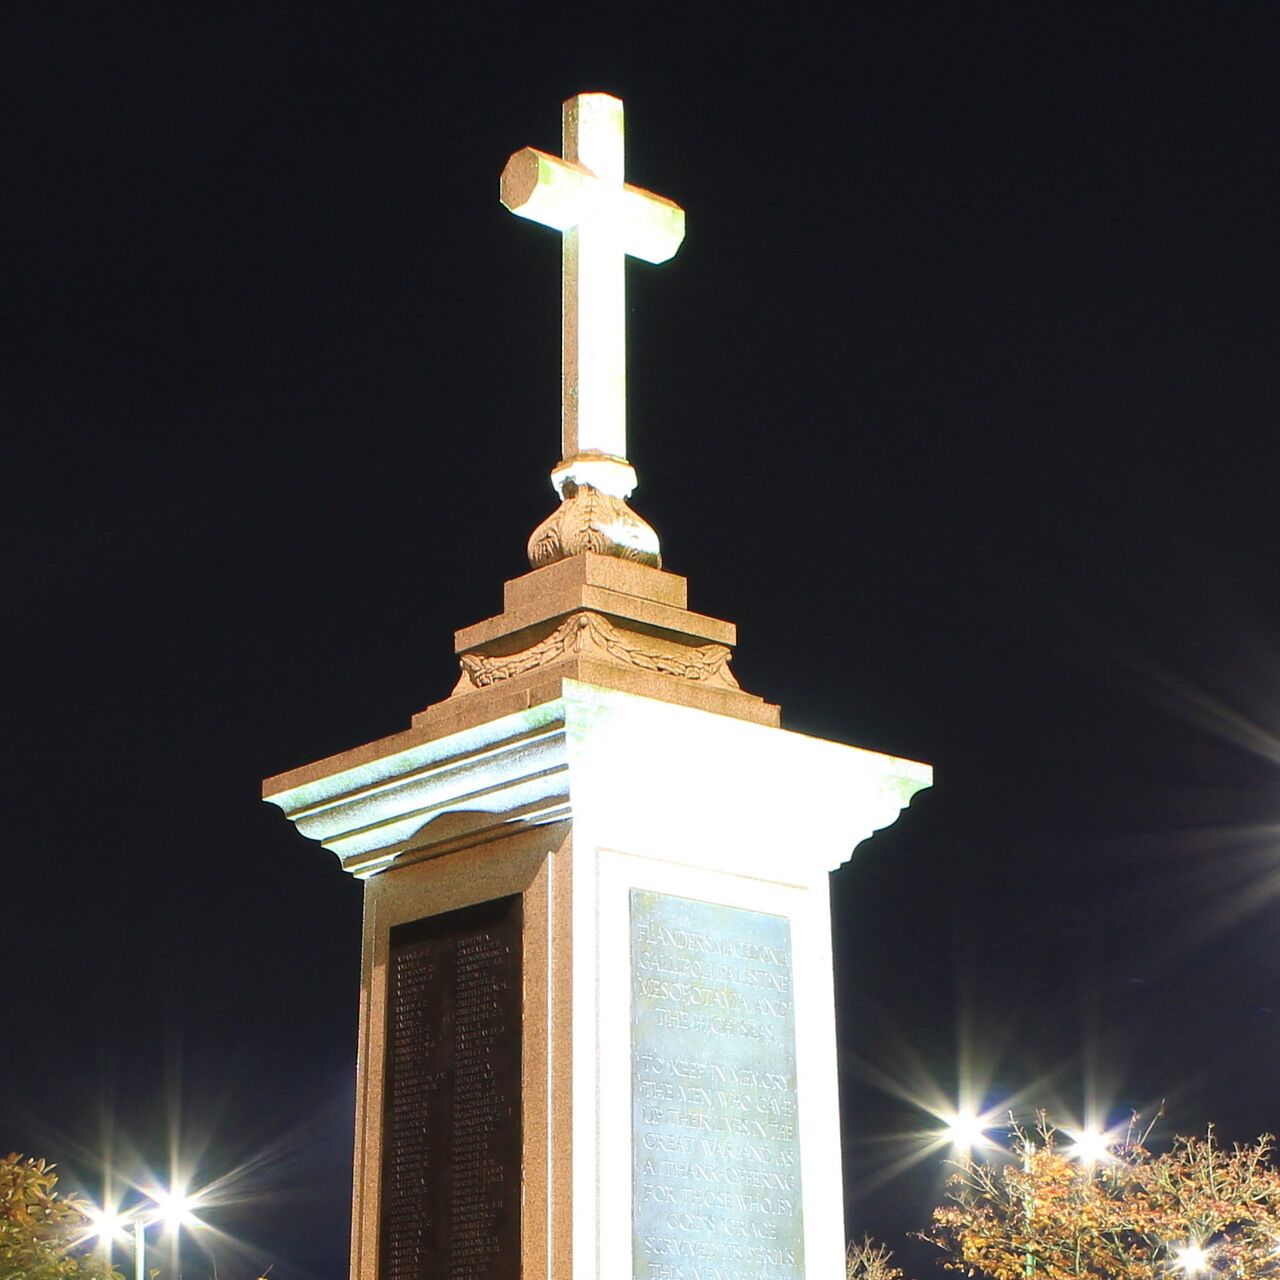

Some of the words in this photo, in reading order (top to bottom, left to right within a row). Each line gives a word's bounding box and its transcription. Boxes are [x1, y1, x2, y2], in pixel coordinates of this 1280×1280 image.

[655, 1007, 689, 1029] THE
[694, 1013, 737, 1036] HIGH
[641, 1054, 665, 1074] TO
[671, 1058, 706, 1079] KEEP
[710, 1064, 726, 1082] IN
[641, 1080, 673, 1101] THE
[678, 1085, 712, 1106] MEN
[717, 1090, 752, 1111] WHO
[756, 1095, 793, 1116] GAVE
[641, 1105, 664, 1125] UP
[643, 1131, 696, 1155] GREAT
[643, 1158, 656, 1176] A
[644, 1184, 679, 1205] FOR
[682, 1188, 732, 1210] THOSE
[777, 1198, 793, 1216] BY
[725, 1217, 777, 1239] GRACE
